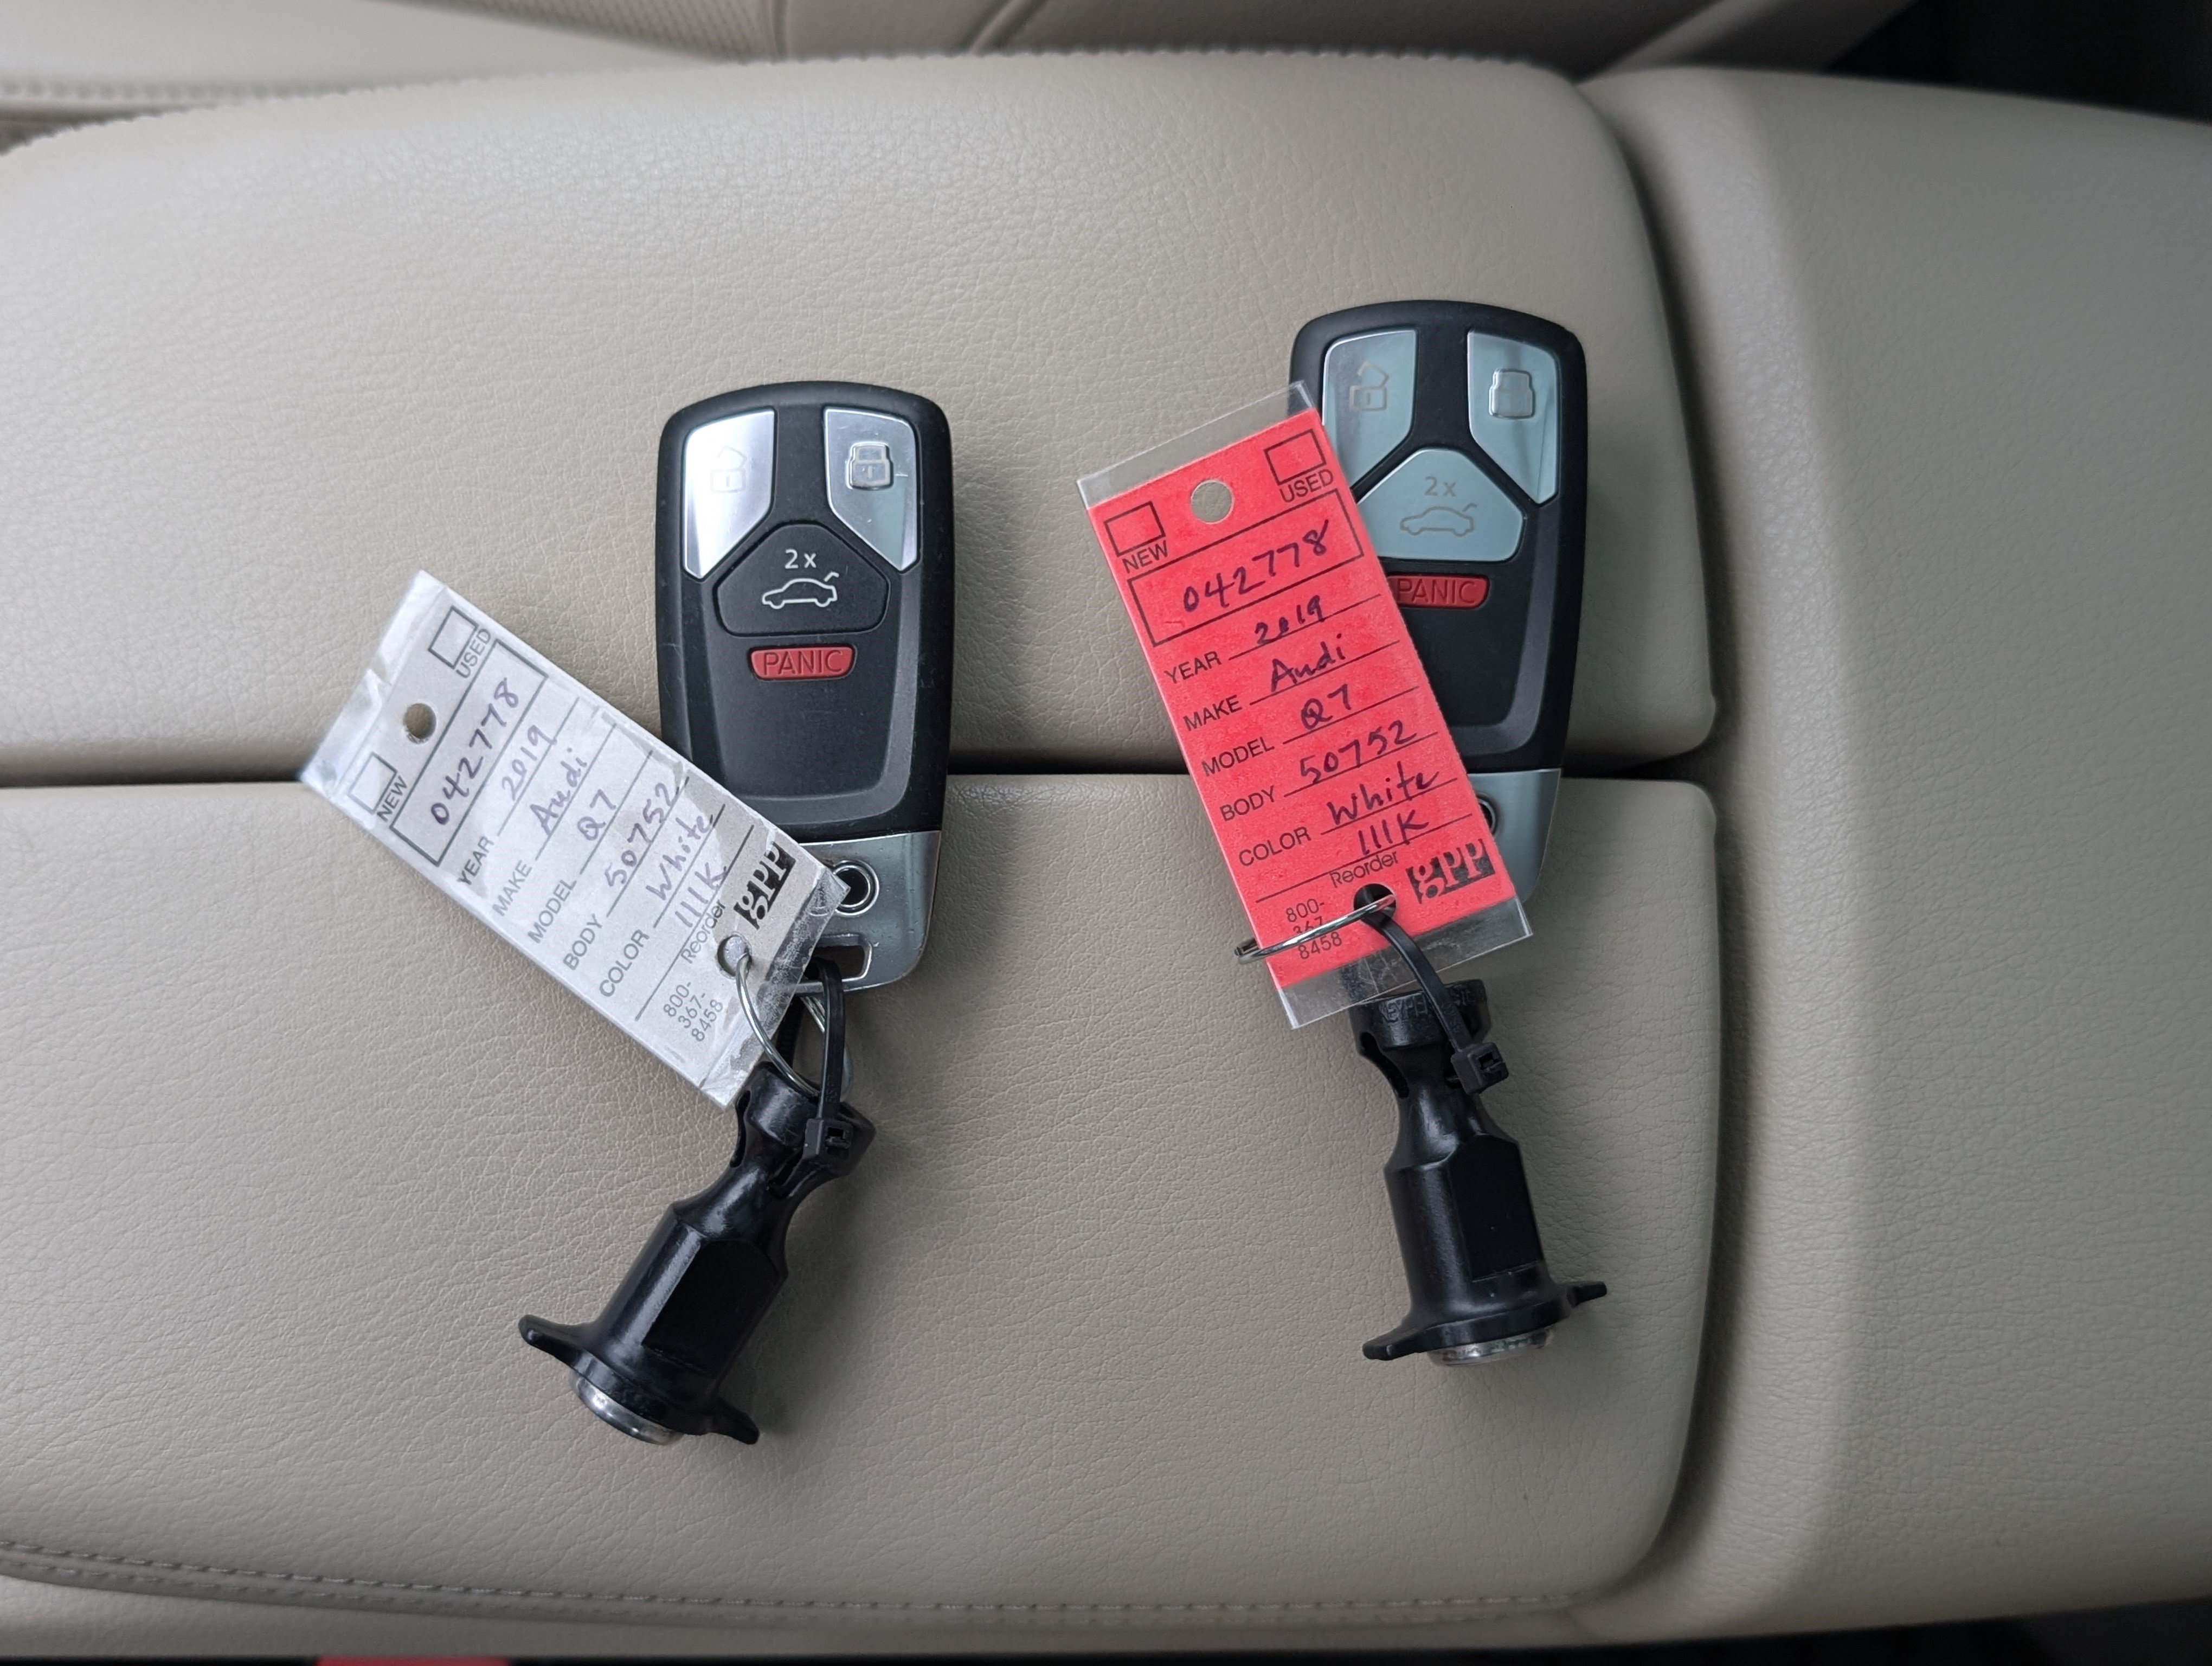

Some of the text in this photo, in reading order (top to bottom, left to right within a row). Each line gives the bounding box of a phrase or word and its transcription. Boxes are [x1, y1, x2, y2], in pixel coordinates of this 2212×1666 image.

[1279, 470, 1334, 503] USED
[1424, 476, 1457, 497] 2x
[784, 548, 817, 569] 2x
[1121, 540, 1169, 574] NEW
[1183, 520, 1329, 612] 042778
[1397, 577, 1476, 605] PANIC
[1255, 594, 1325, 645] 2019
[455, 628, 491, 678] USED
[762, 649, 844, 676] PANIC
[1163, 650, 1222, 685] YEAR
[1270, 633, 1346, 692] Audi
[1182, 694, 1244, 732] MAKE
[1301, 684, 1351, 729] Q7
[430, 677, 519, 825] 042778
[502, 725, 557, 800] 2019
[1201, 736, 1276, 777] MODEL
[1300, 719, 1418, 785] 50752
[378, 777, 408, 822] NEW
[530, 747, 588, 835] Audi
[1219, 785, 1277, 822] BODY
[1327, 760, 1439, 826] White
[577, 789, 616, 841] Q7
[605, 781, 679, 888] 50752
[456, 835, 496, 886] YEAR
[645, 813, 715, 901] White
[1238, 826, 1312, 867] COLOR
[1329, 850, 1400, 888] Reorder
[493, 859, 532, 917] MAKE
[526, 872, 577, 944] MODEL
[1285, 898, 1325, 923] 800-
[562, 913, 603, 971] BODY
[680, 901, 726, 964] Reorder
[1297, 932, 1342, 959] 8458
[599, 929, 650, 997] COLOR
[663, 981, 692, 1018] 800-
[677, 992, 706, 1029] 367-
[692, 998, 724, 1042] 8458
